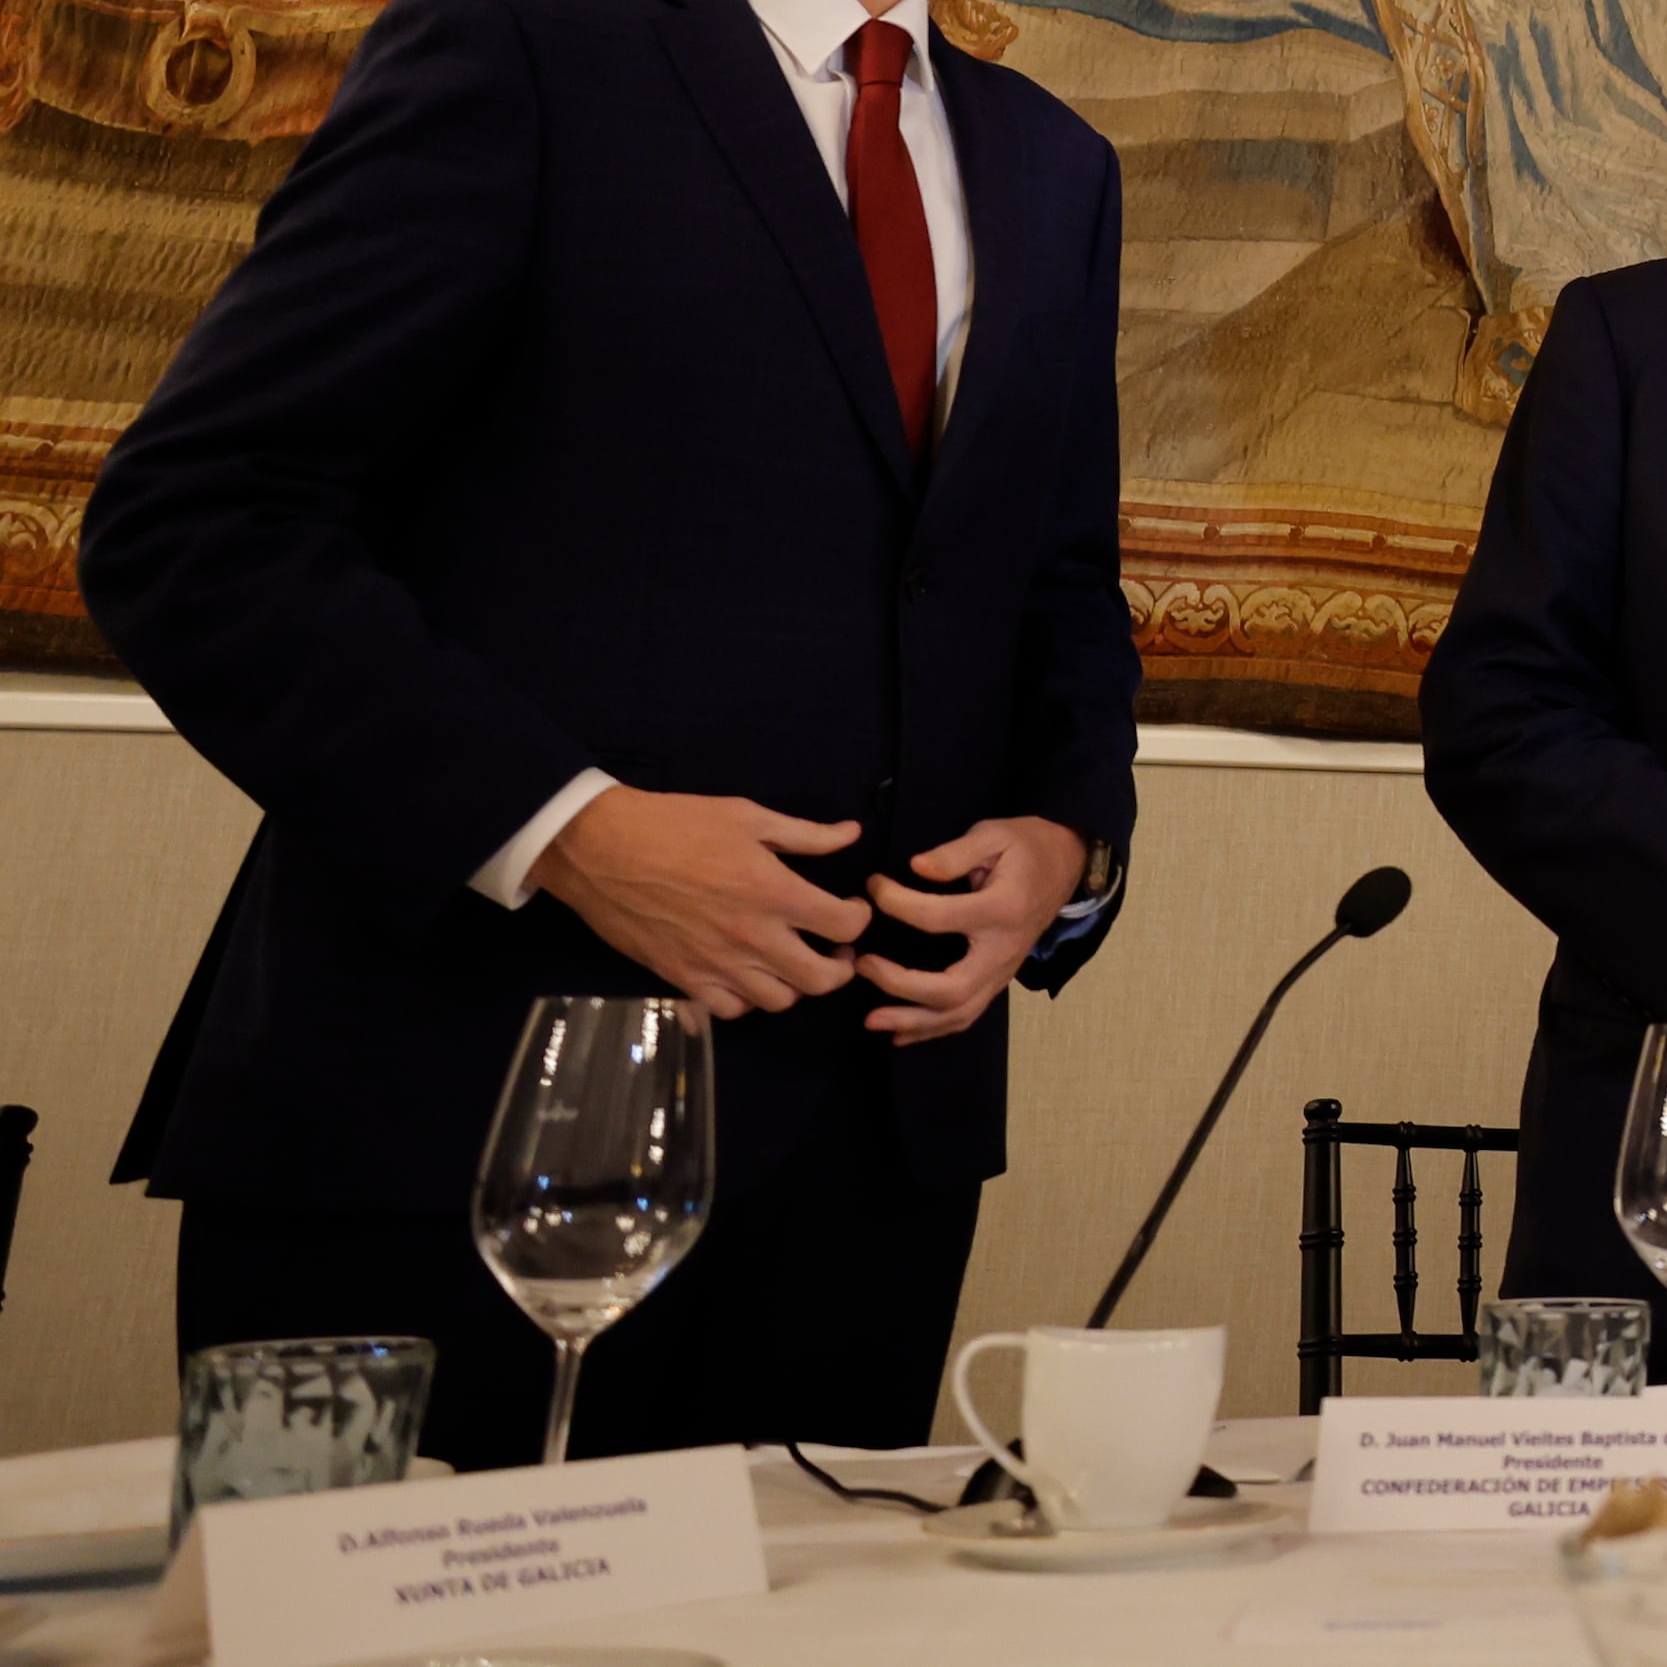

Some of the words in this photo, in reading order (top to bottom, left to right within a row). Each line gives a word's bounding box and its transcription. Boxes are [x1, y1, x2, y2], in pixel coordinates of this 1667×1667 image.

[1386, 1433, 1430, 1447] Juan
[1438, 1432, 1505, 1446] Manuel
[1512, 1432, 1574, 1445] Vieites
[1582, 1431, 1657, 1448] Baptista
[1504, 1455, 1603, 1469] Presidente
[1361, 1476, 1529, 1495] CONFEDERACIÓN
[1536, 1478, 1561, 1493] DE
[457, 1515, 527, 1535] Rueda
[530, 1497, 647, 1528] Valenzuela
[1508, 1500, 1591, 1517] GALICIA
[441, 1539, 561, 1567] Presidente
[394, 1579, 474, 1606] XUNTA
[479, 1572, 509, 1592] DE
[516, 1557, 611, 1588] GALICIA
